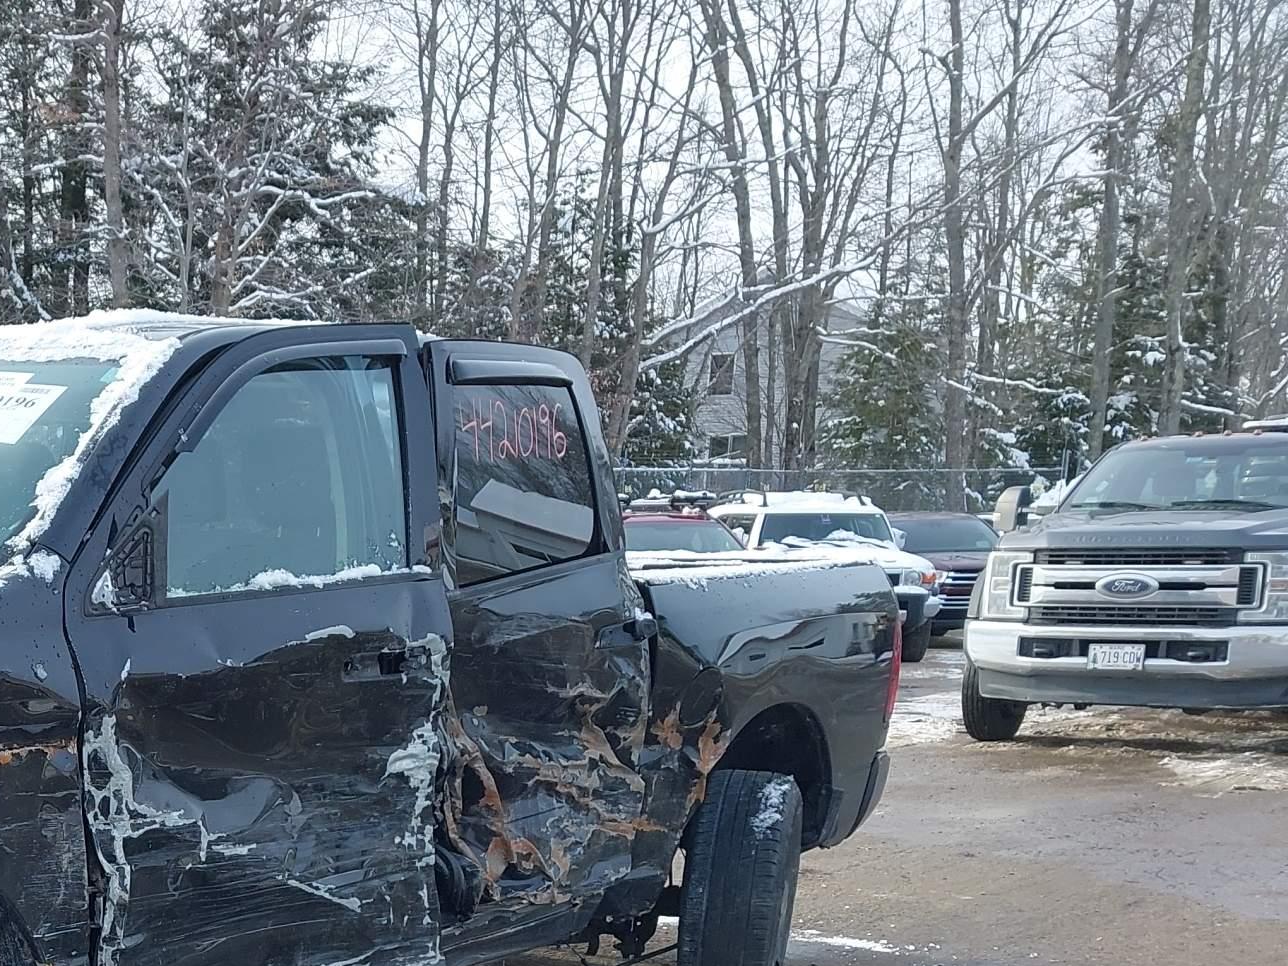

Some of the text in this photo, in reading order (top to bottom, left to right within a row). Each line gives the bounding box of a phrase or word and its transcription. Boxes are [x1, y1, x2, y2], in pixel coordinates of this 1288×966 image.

[458, 398, 568, 463] 44210196
[1111, 579, 1142, 592] Ford
[1100, 650, 1120, 664] 719
